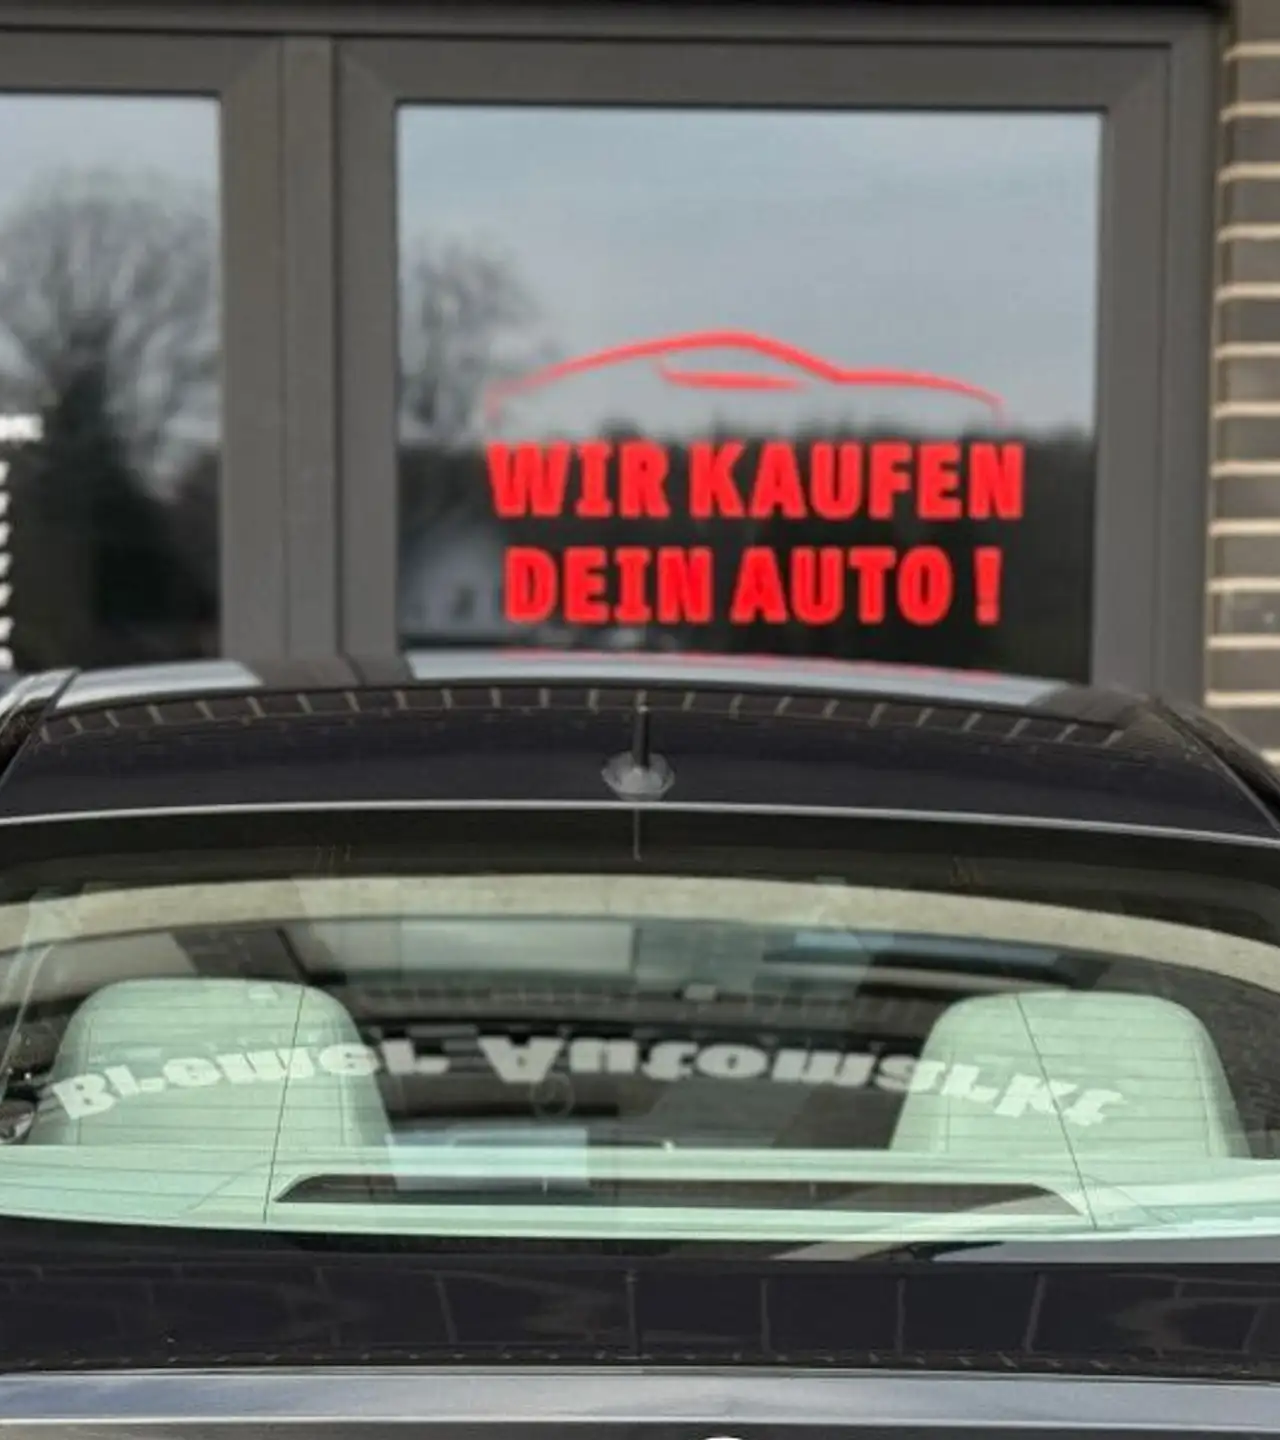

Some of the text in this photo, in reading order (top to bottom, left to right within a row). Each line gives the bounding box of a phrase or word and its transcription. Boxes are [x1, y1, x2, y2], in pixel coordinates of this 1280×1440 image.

[486, 441, 1024, 519] WIR KAUFEN
[503, 545, 1001, 625] DEIN AUTO !
